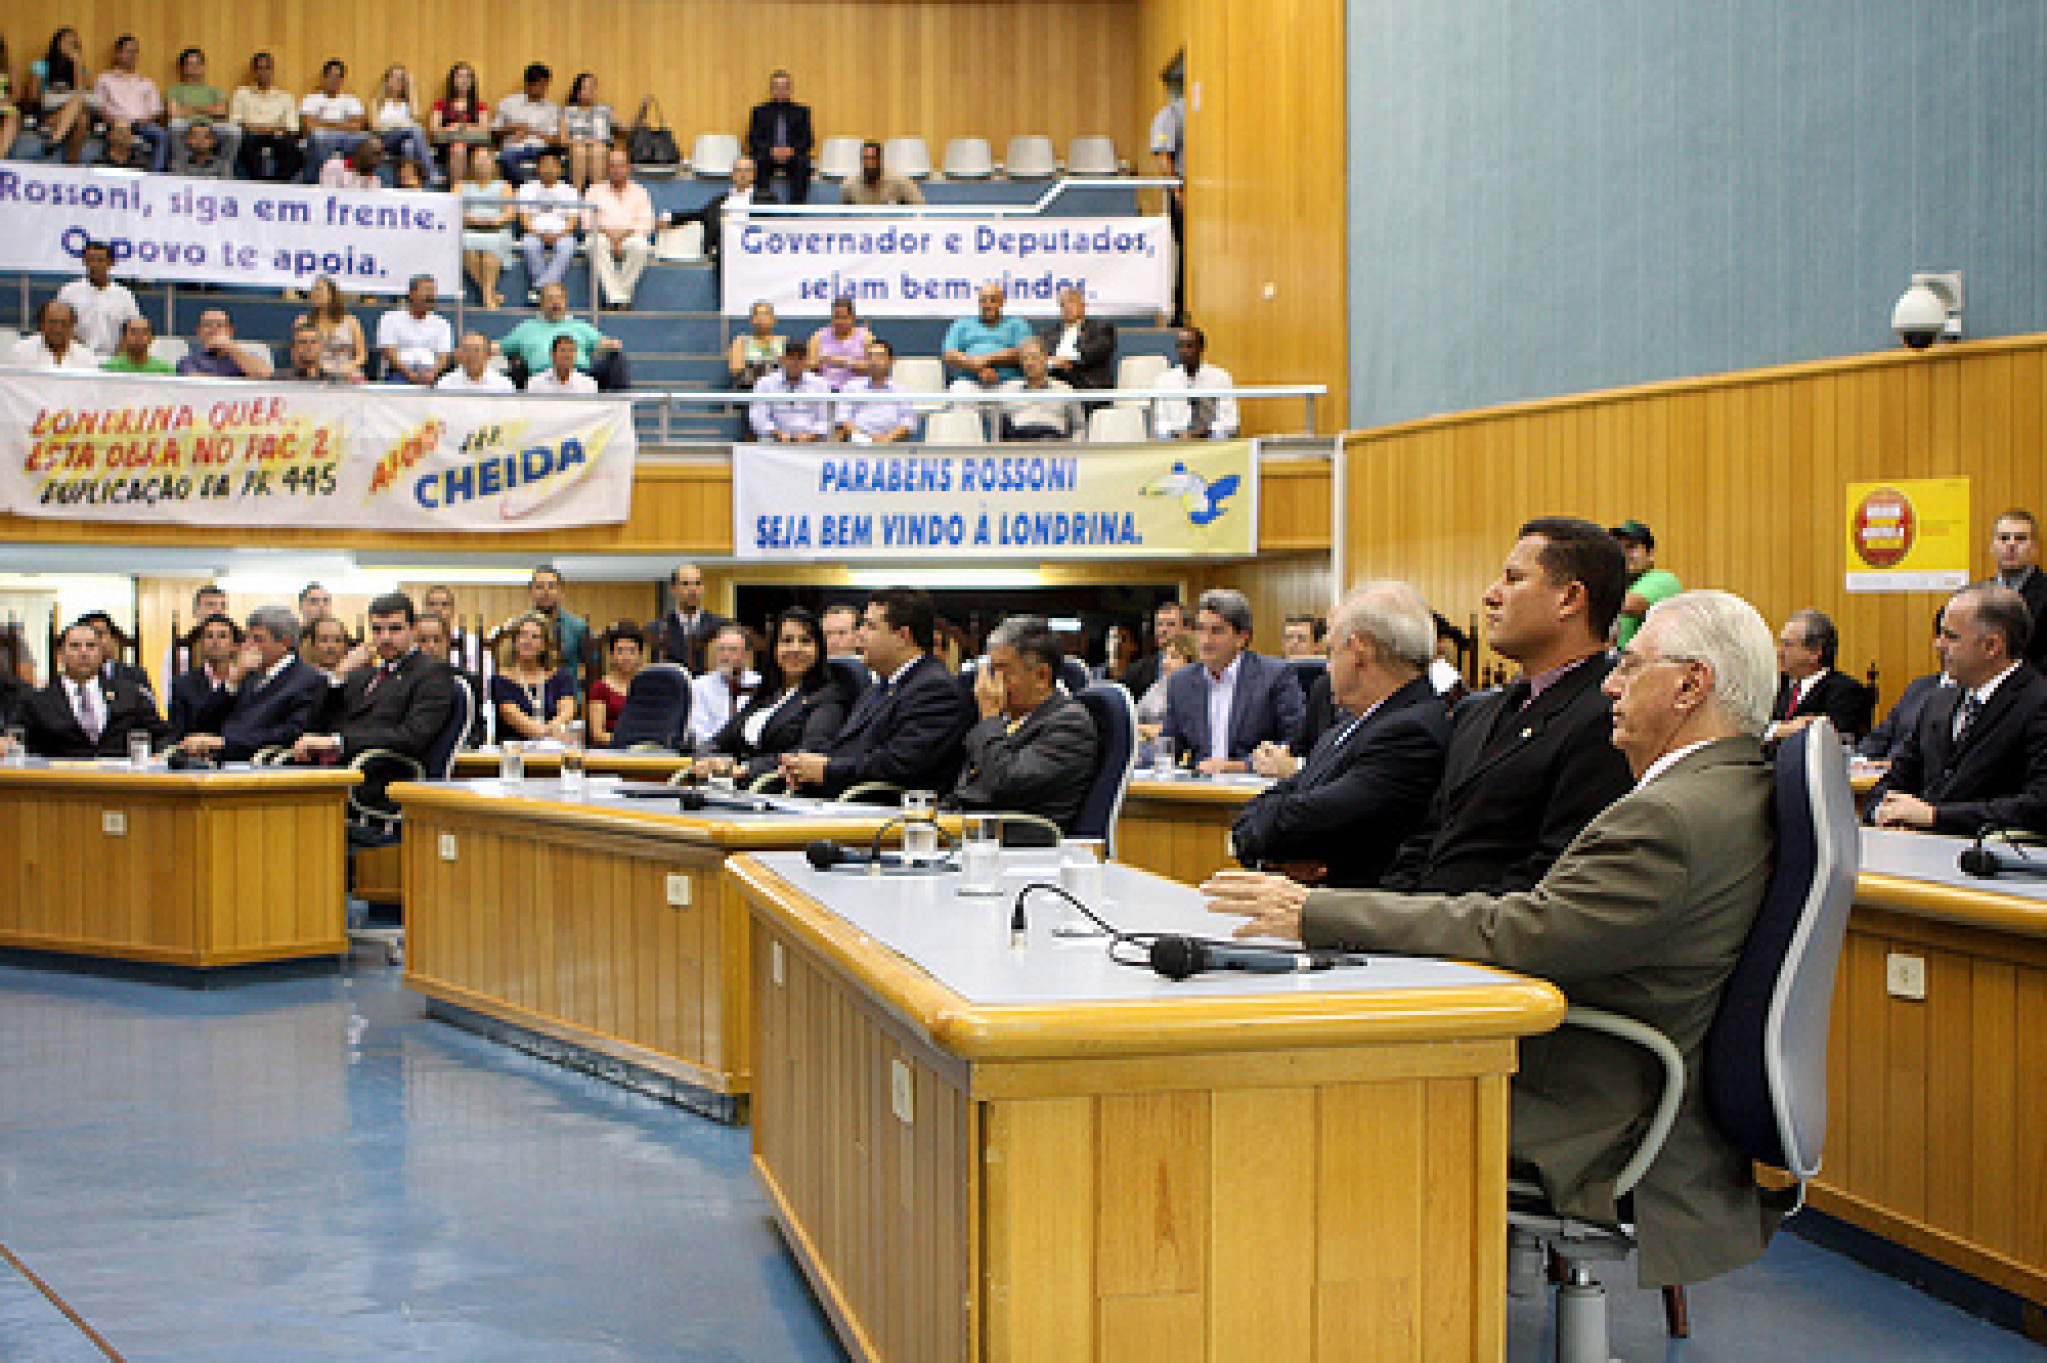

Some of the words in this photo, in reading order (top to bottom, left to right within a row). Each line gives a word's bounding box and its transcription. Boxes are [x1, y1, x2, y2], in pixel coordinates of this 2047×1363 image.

[0, 171, 152, 217] Rossoni,
[171, 184, 239, 224] siga
[254, 198, 311, 223] em
[325, 196, 447, 231] frente.
[61, 226, 90, 258] O
[110, 236, 207, 266] povo
[221, 240, 259, 268] te
[273, 245, 388, 278] apoia.
[740, 225, 933, 254] Governador
[945, 231, 962, 253] e
[974, 225, 1155, 258] Deputados,
[29, 404, 193, 436] LONDRINA
[24, 437, 95, 471] ESTA
[106, 437, 181, 468] OBRA
[192, 436, 234, 463] NO
[244, 433, 297, 462] PAC
[311, 428, 330, 459] 2
[283, 462, 337, 497] 445
[414, 437, 586, 508] CHEIDA
[961, 458, 1079, 491] ROSSONI
[755, 514, 812, 549] SEJA
[820, 514, 873, 547] BEM
[881, 512, 964, 546] VINDO
[999, 512, 1143, 546] LONDRINA.
